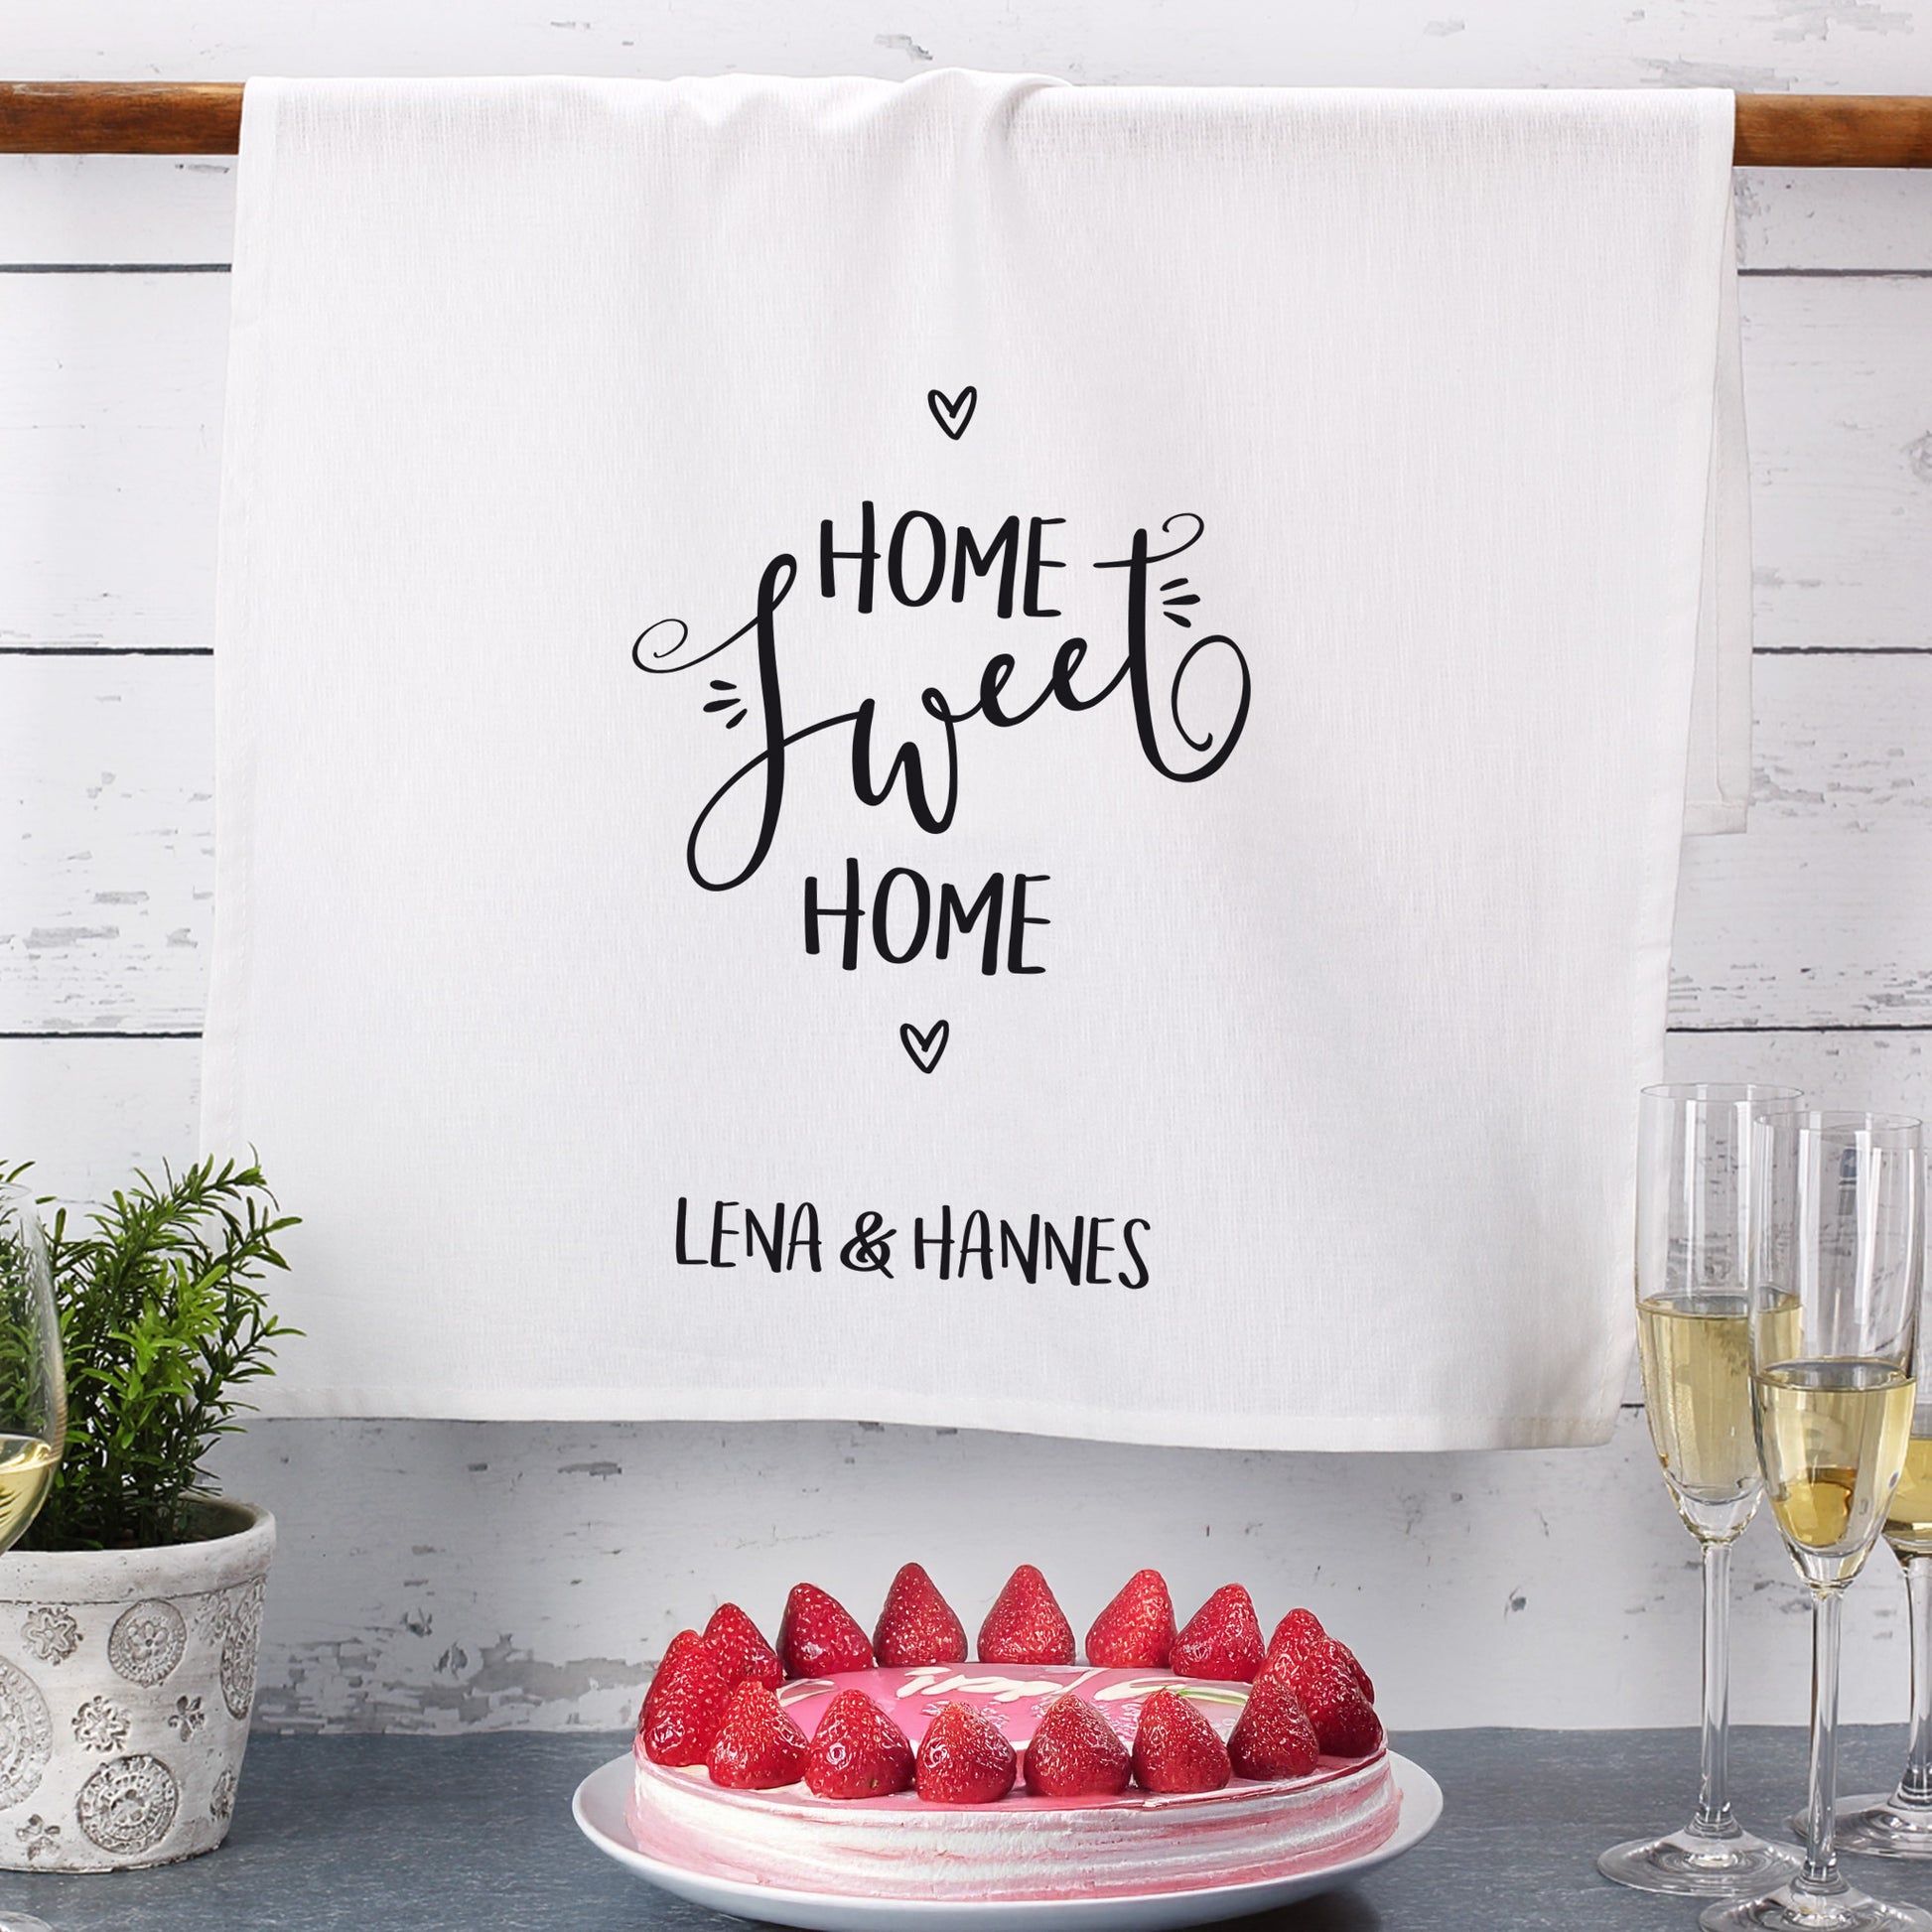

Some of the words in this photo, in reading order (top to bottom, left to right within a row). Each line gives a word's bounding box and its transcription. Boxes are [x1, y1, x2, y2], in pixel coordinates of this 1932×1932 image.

[820, 500, 1066, 620] HOME
[804, 857, 1051, 976] HOME
[675, 1196, 822, 1274] LENA
[839, 1210, 897, 1280] &
[914, 1204, 1151, 1290] HANNES
